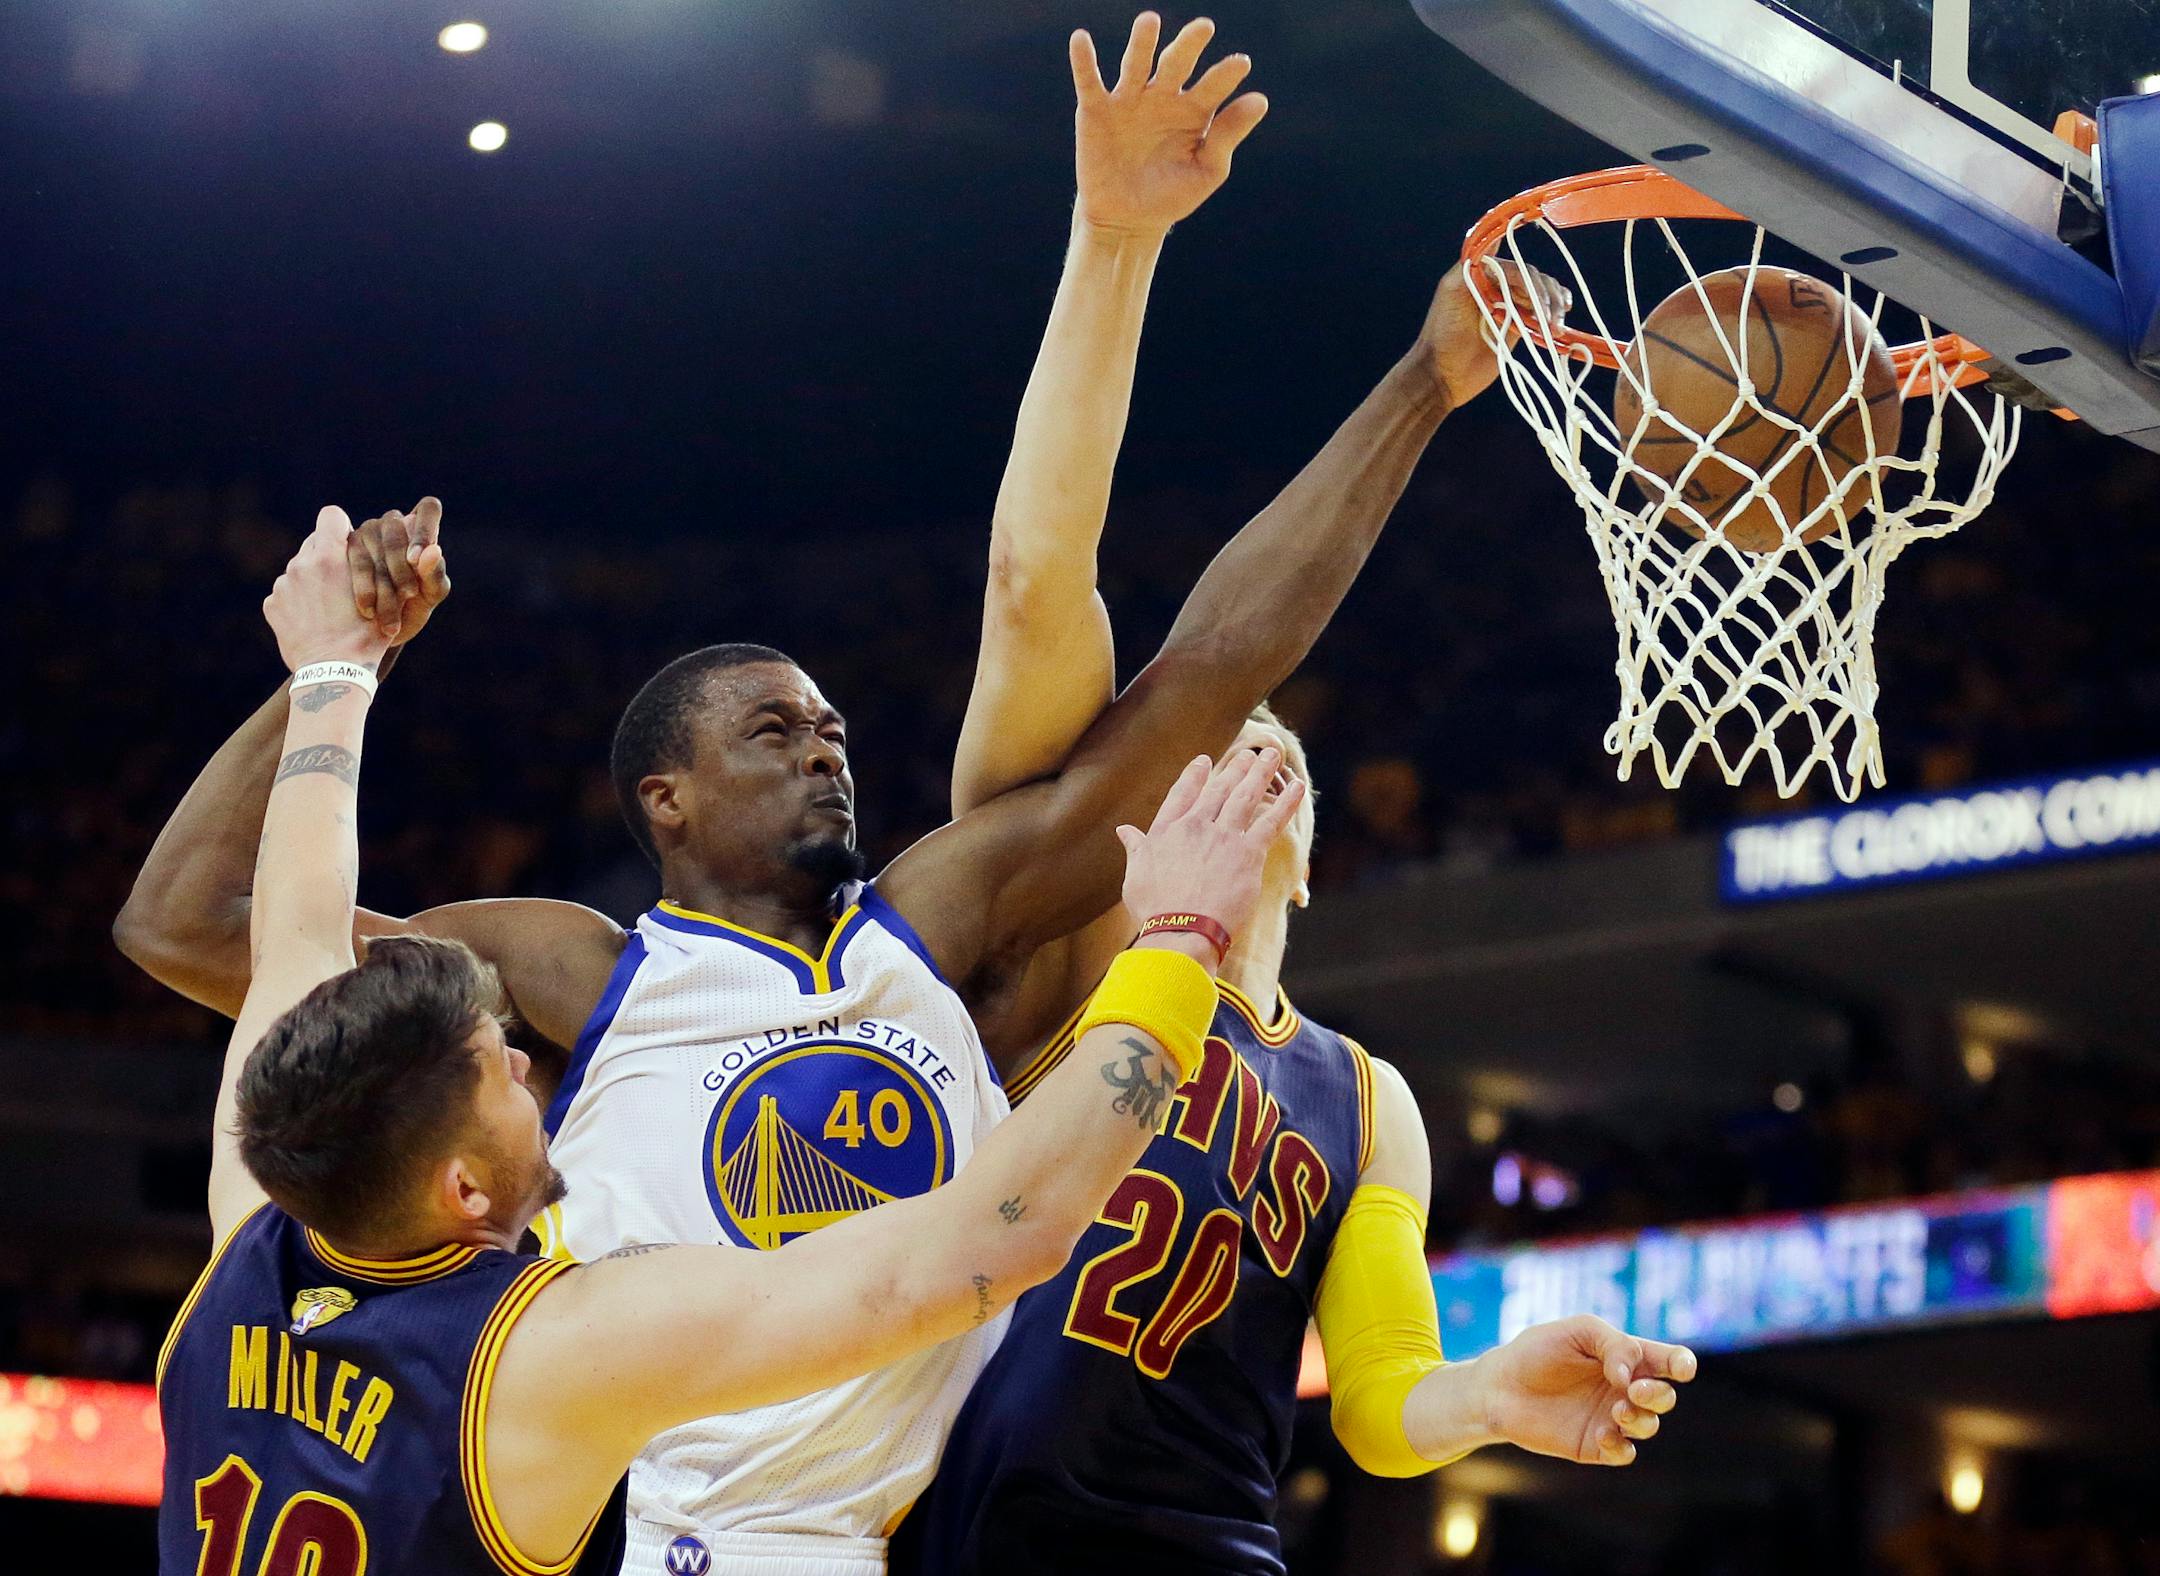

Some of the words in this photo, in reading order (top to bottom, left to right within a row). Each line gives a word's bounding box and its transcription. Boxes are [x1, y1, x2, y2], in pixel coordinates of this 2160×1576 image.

[1731, 817, 1832, 892] THE
[1831, 790, 2043, 879] CLOROX
[703, 1016, 840, 1091] GOLDEN
[856, 1021, 956, 1090] STATE
[823, 1088, 912, 1148] 40
[1154, 1036, 1331, 1278] AVS
[1063, 1168, 1243, 1380] 20
[227, 1324, 394, 1464] MILLER
[671, 1545, 706, 1572] W
